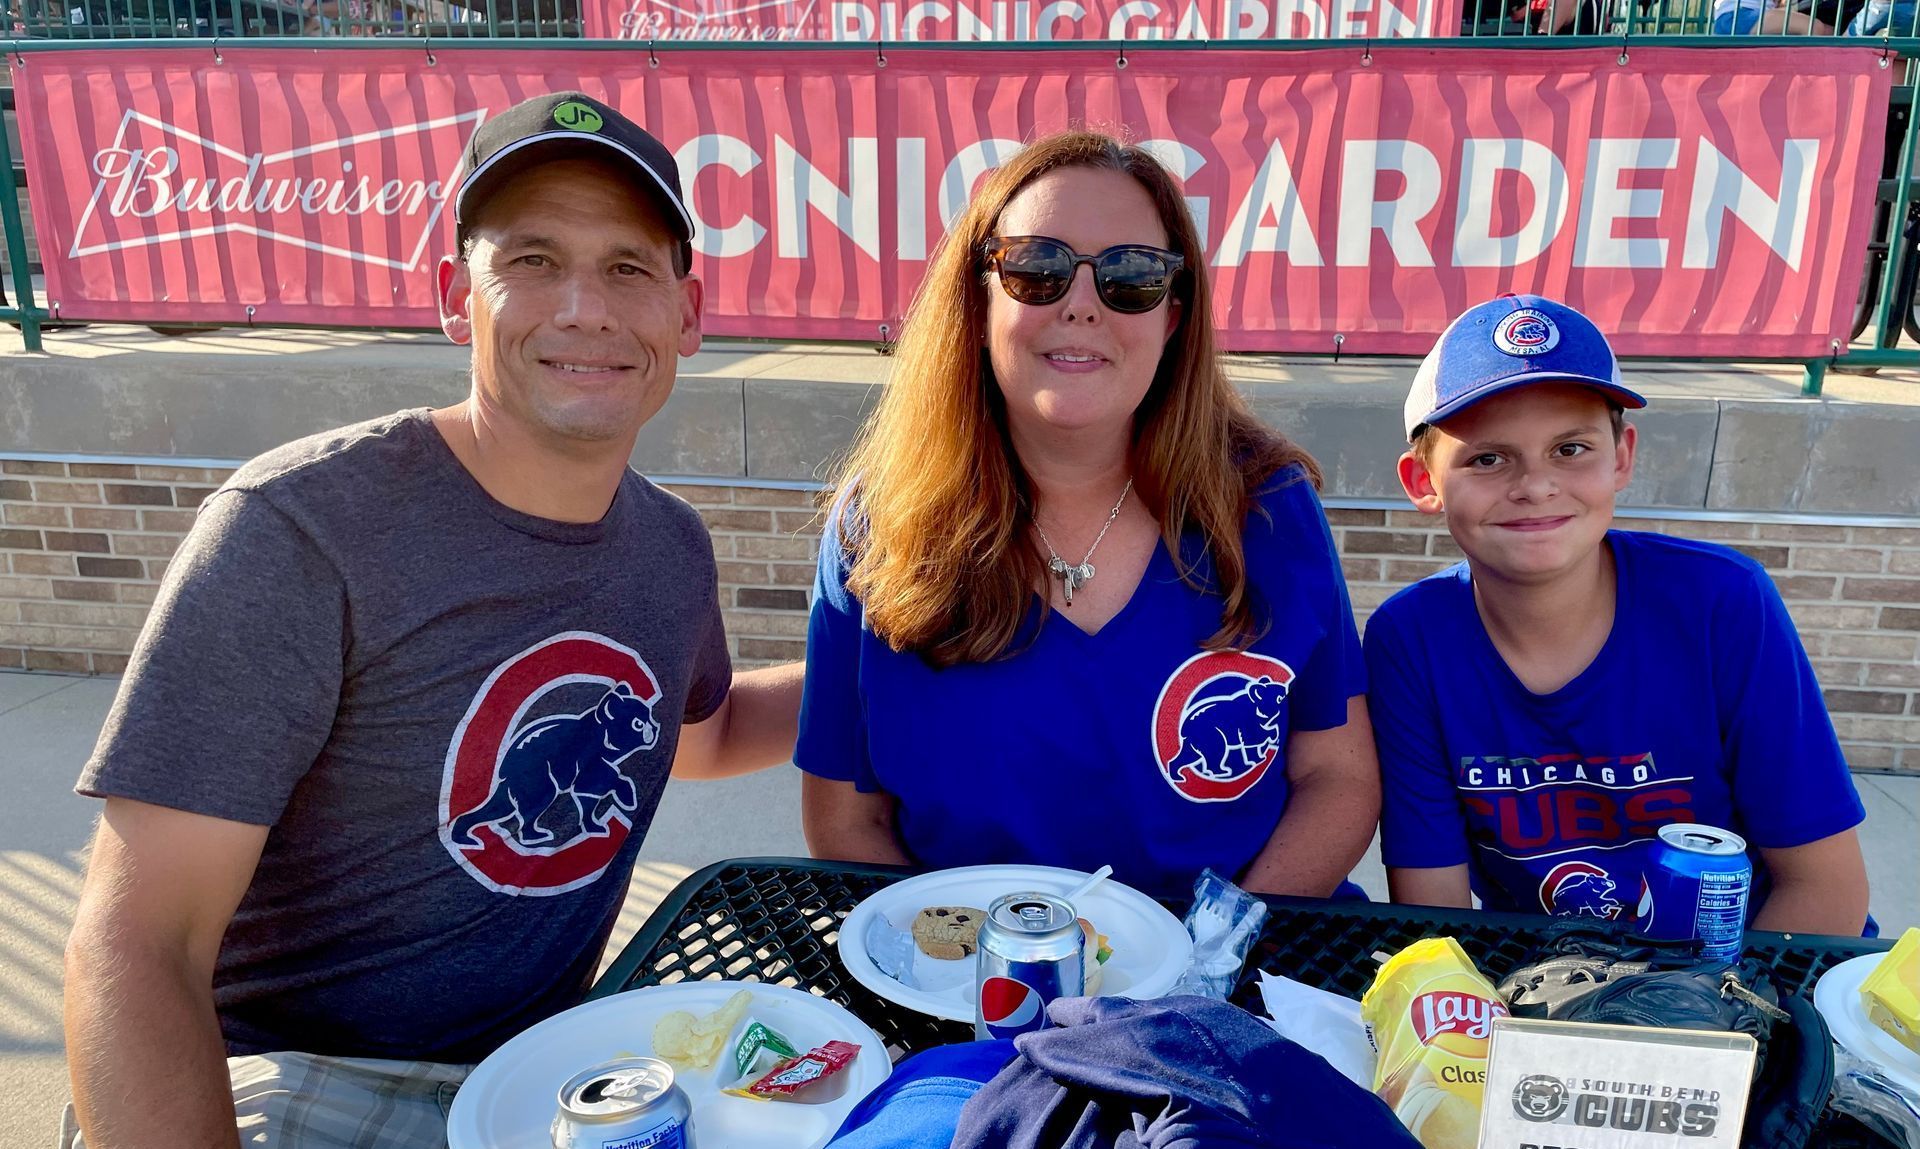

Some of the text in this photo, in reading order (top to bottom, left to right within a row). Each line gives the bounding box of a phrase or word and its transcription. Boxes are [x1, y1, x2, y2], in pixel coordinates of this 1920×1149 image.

[618, 10, 803, 40] Budweiser
[832, 0, 1432, 41] PICNIC GARDEN
[93, 145, 442, 218] Budweiser
[674, 133, 1023, 262] CNI
[1469, 764, 1648, 785] CHICAGO
[1703, 873, 1736, 882] Nutrition
[1700, 898, 1731, 907] Calories
[1441, 1066, 1485, 1083] Clas
[1581, 1078, 1651, 1097] SOUTH
[1661, 1086, 1721, 1102] BEND
[1574, 1093, 1720, 1138] CUBS
[606, 1123, 677, 1149] rition Facts
